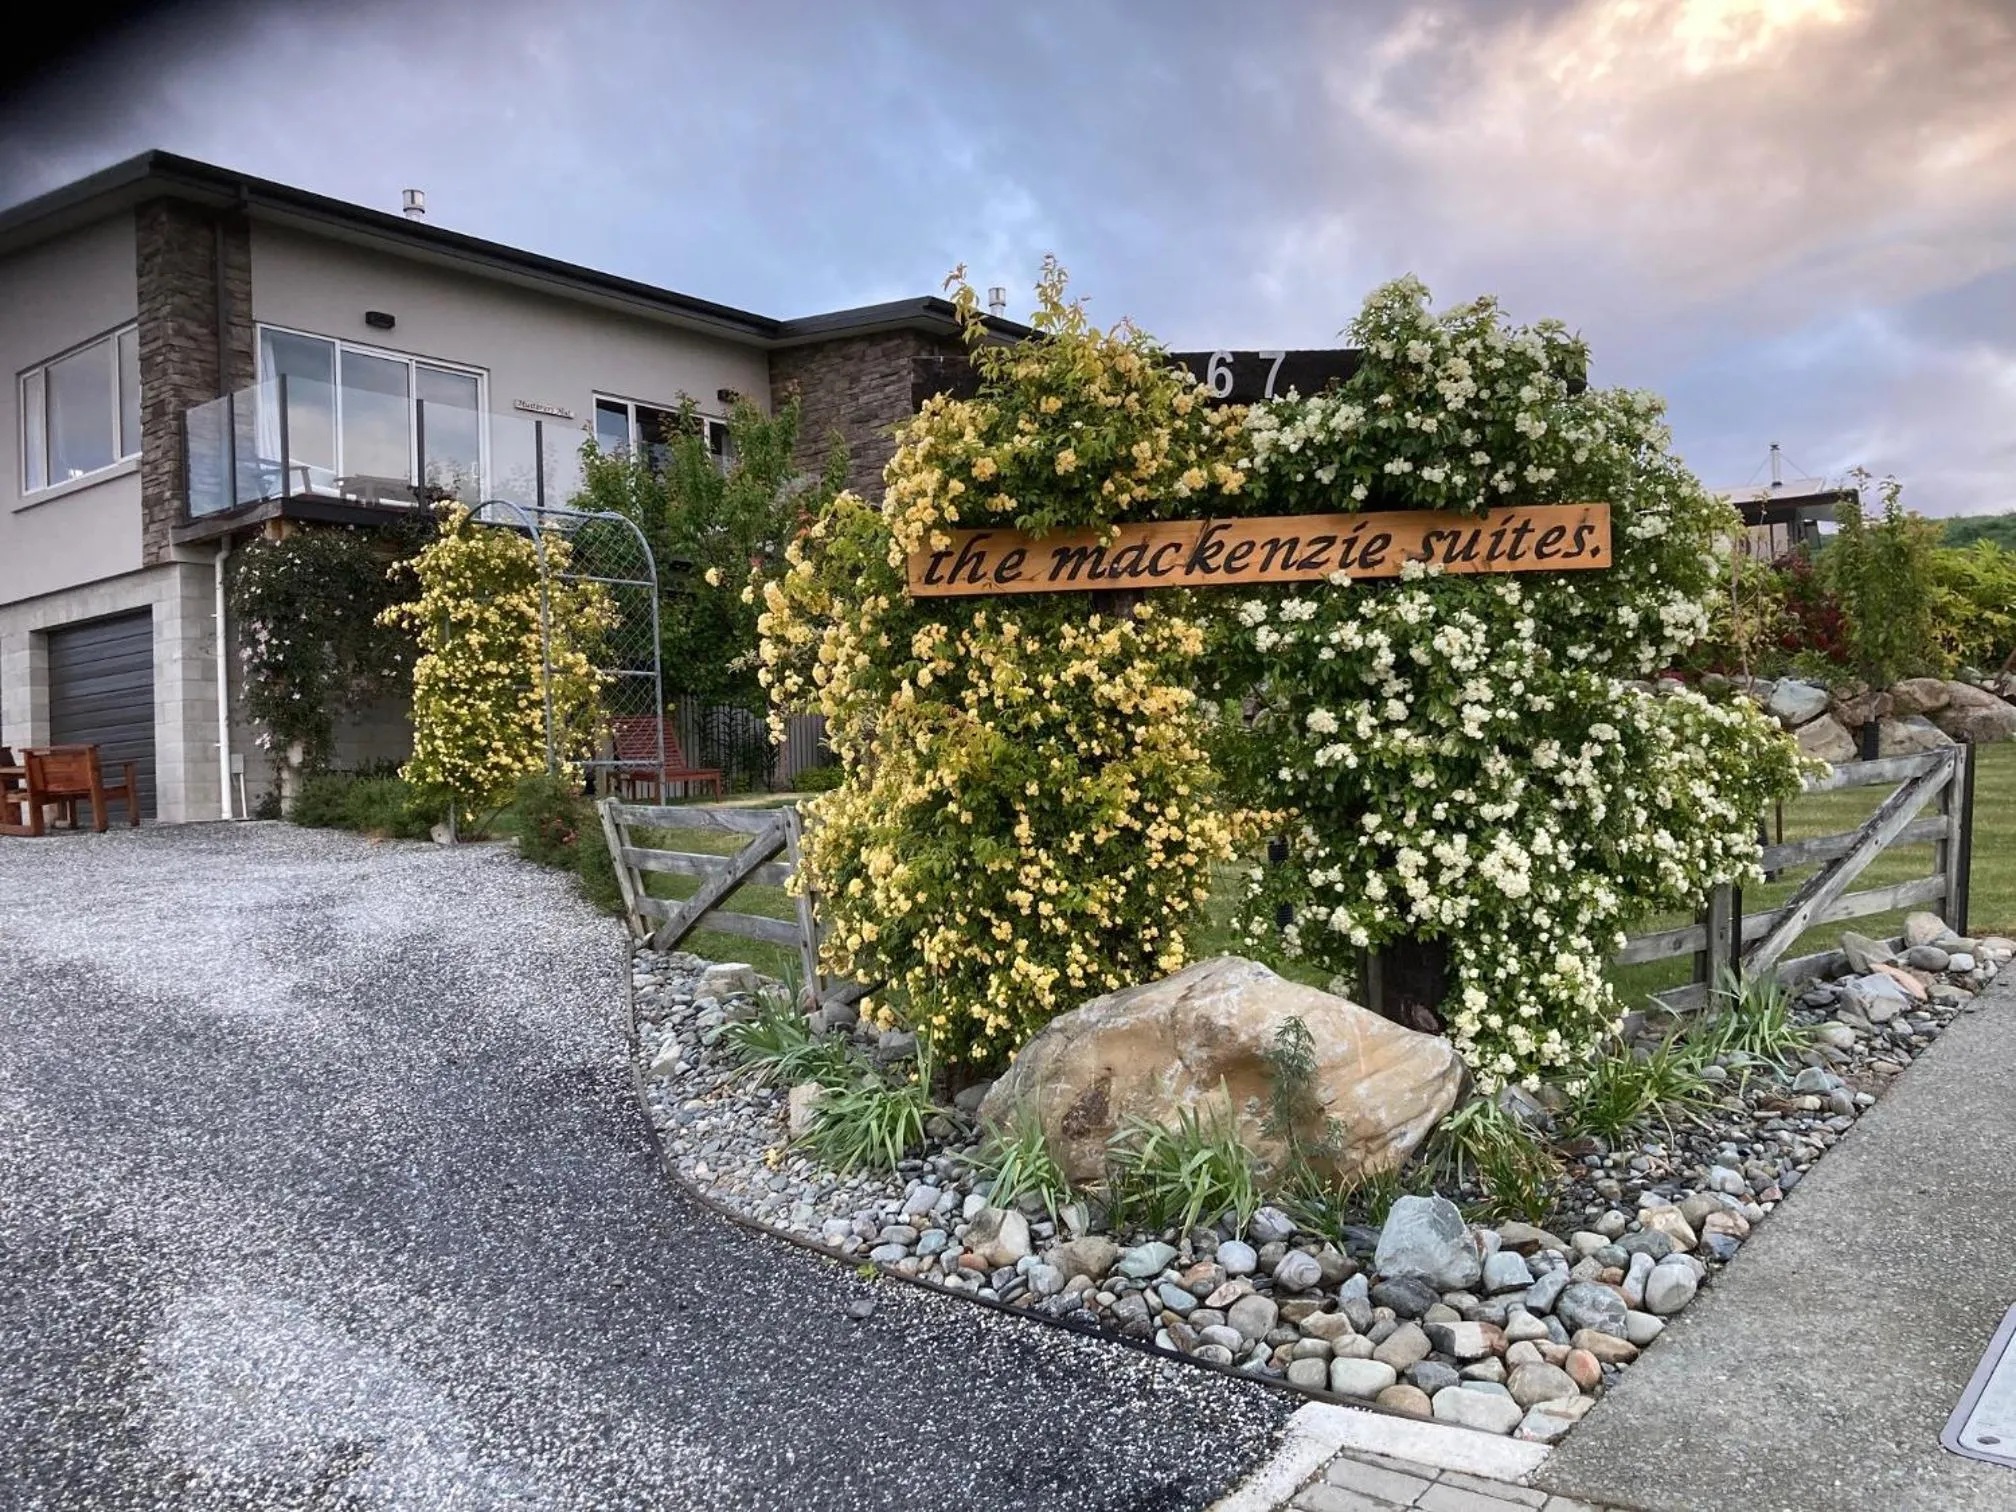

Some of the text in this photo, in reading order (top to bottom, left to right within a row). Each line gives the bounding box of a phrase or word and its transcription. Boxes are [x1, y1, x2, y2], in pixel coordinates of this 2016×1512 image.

[1207, 350, 1286, 399] 67
[924, 514, 1601, 585] the mackenzie suites.
